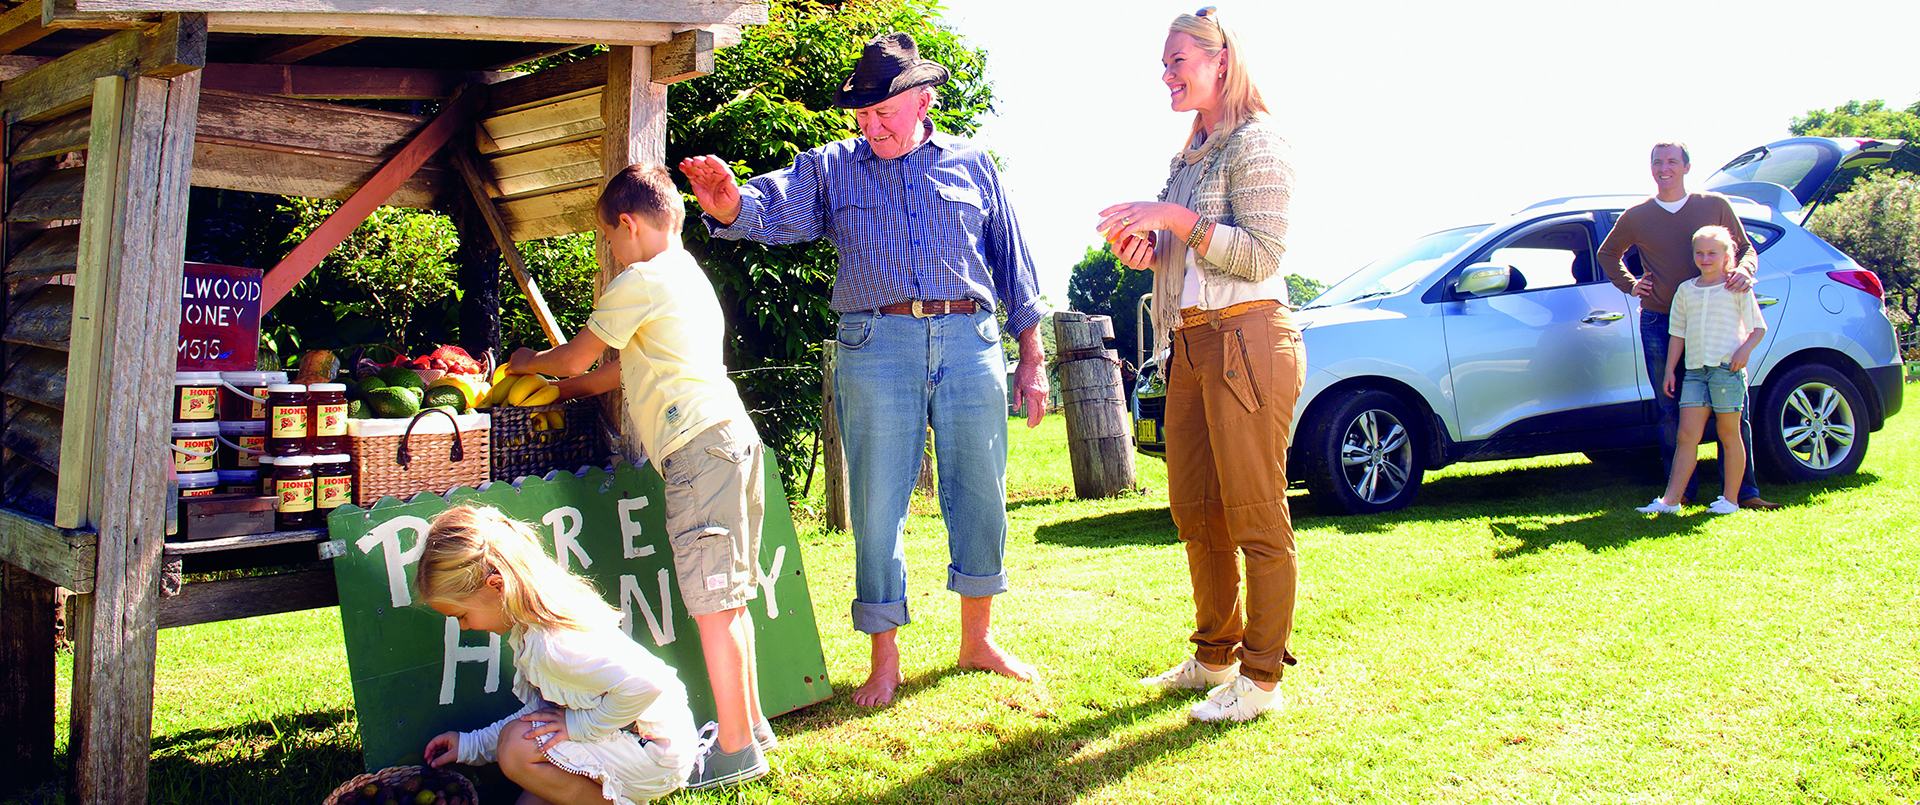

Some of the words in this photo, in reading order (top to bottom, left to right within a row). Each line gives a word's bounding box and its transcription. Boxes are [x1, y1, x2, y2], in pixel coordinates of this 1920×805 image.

[180, 303, 244, 327] ONEY
[354, 495, 657, 609] PRE
[438, 544, 787, 706] HNY
